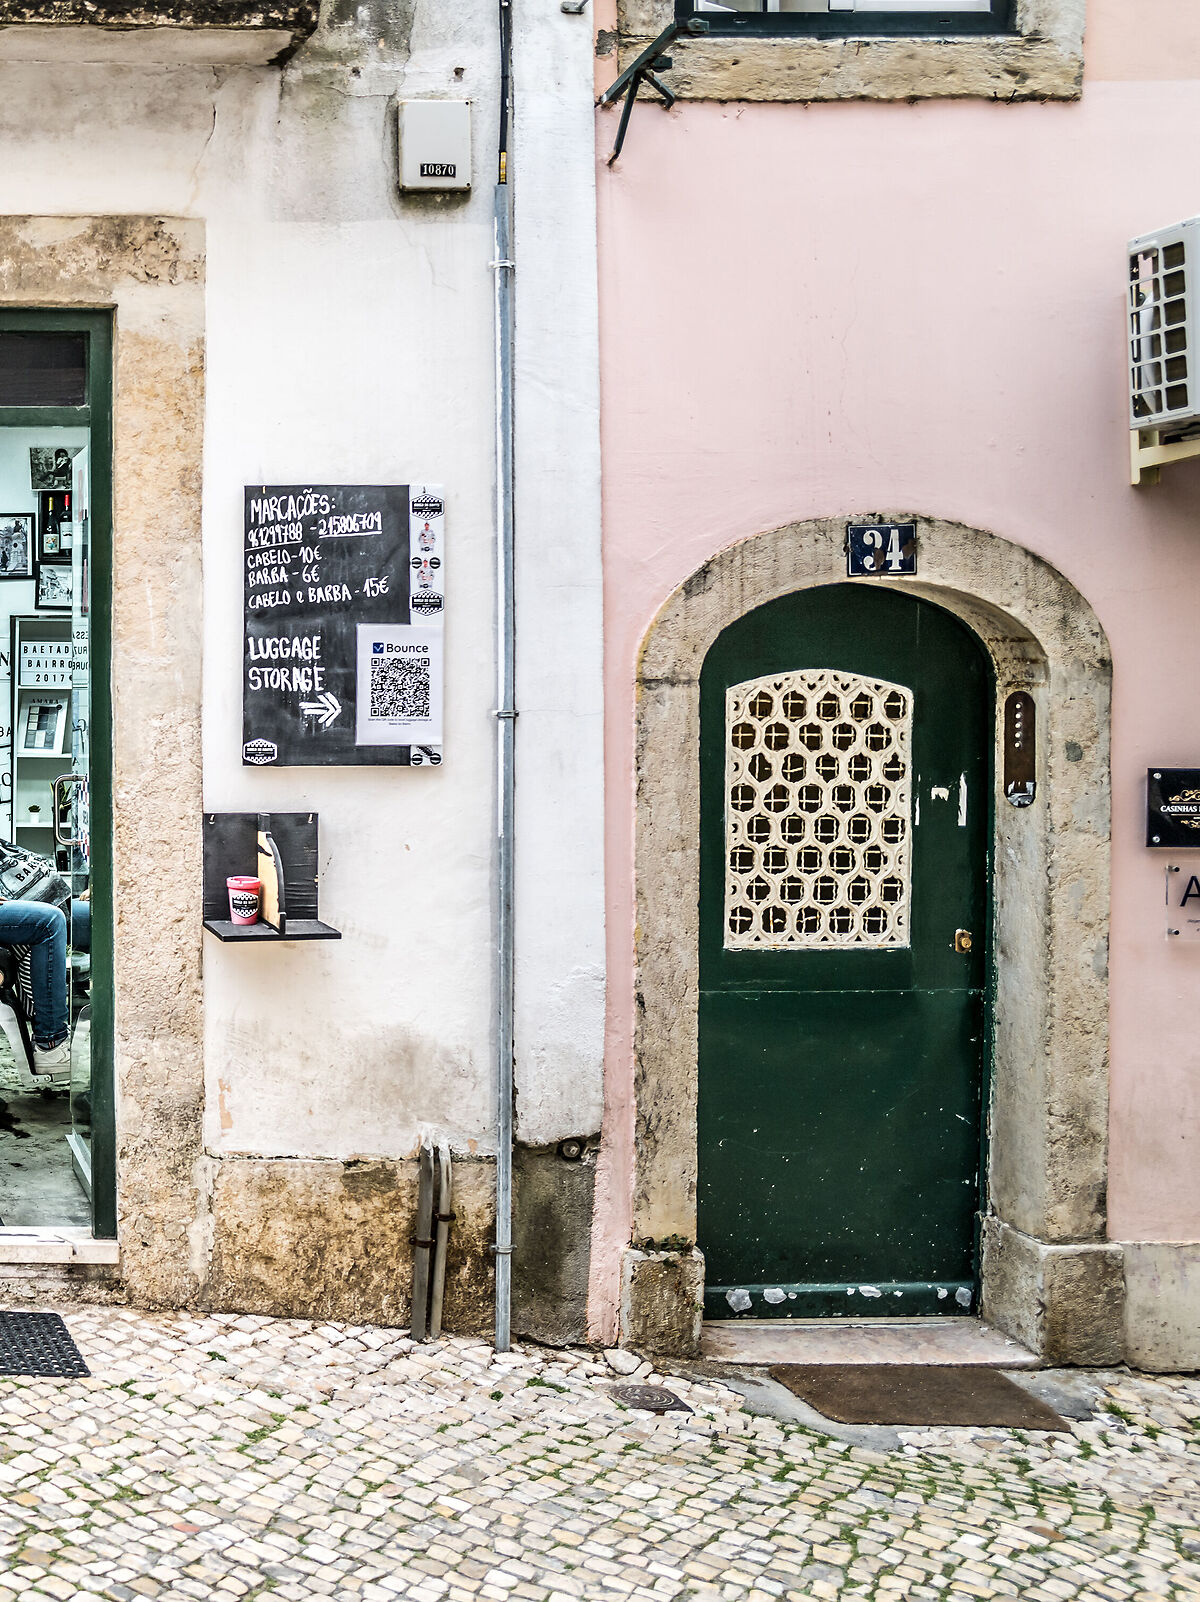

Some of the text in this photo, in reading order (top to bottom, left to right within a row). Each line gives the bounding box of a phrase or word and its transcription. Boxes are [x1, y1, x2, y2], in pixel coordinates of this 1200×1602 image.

[423, 164, 454, 176] 10870
[862, 528, 904, 571] 34
[248, 566, 289, 588] BARBA
[302, 564, 320, 584] 6€
[248, 590, 291, 609] CABELO
[308, 584, 352, 604] BARBA
[363, 575, 390, 598] 15€
[248, 636, 322, 660] LUGGAGE
[386, 643, 429, 653] Bounce
[28, 660, 72, 668] BAIRRO
[36, 674, 65, 682] 2017
[248, 666, 326, 692] STORAGE
[1160, 804, 1198, 813] CASINHAS
